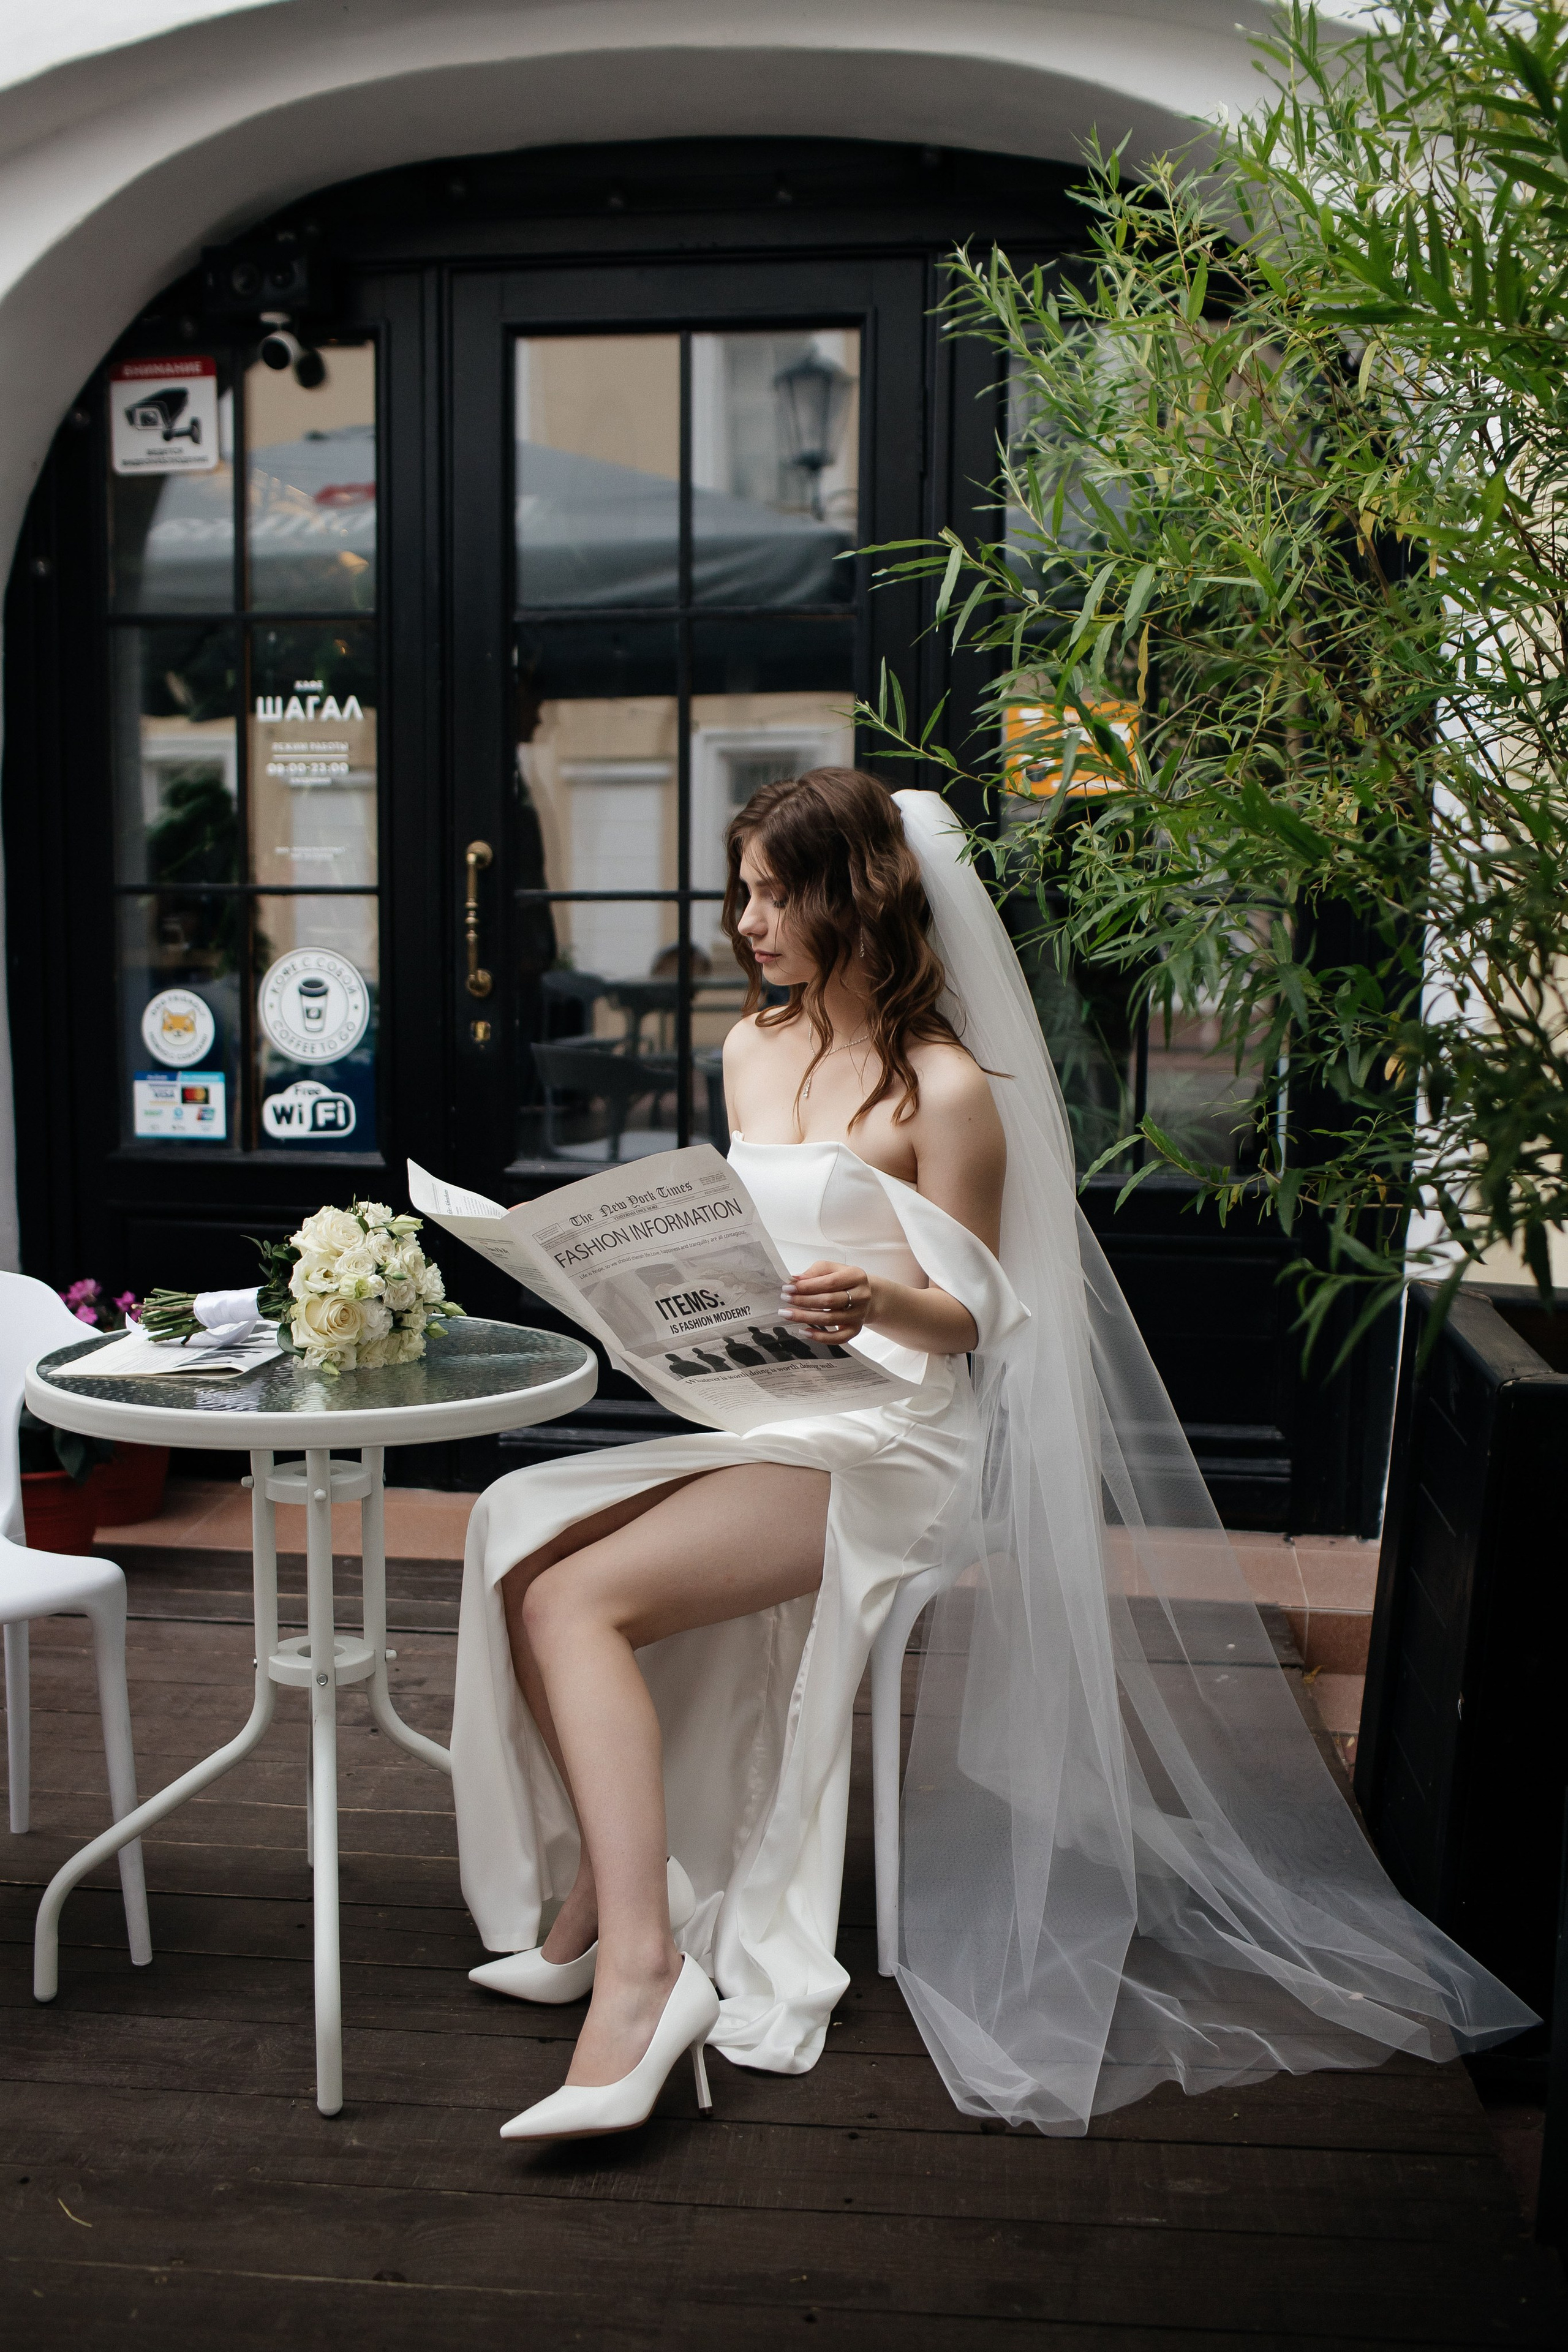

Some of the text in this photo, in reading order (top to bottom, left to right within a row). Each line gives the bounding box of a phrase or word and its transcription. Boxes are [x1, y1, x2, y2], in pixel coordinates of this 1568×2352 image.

[256, 695, 364, 722] ШАГАЛ
[271, 963, 297, 993] КОФЕ
[272, 1020, 356, 1053] COFFEE TO GO
[294, 1085, 321, 1095] Free
[569, 1213, 594, 1227] The
[599, 1201, 628, 1218] New
[625, 1190, 657, 1208] York
[656, 1181, 693, 1198] Times
[554, 1227, 631, 1268] FASHION
[628, 1198, 742, 1240] INFORMATION
[617, 1256, 631, 1264] should
[660, 1245, 680, 1255] happiness
[655, 1289, 725, 1321] ITEMS:
[669, 1305, 751, 1334] IS FASHION MODERN?
[685, 1376, 720, 1385] Whatever
[727, 1371, 749, 1380] worth
[749, 1367, 771, 1377] doing
[777, 1363, 799, 1372] worth
[799, 1362, 820, 1370] doing
